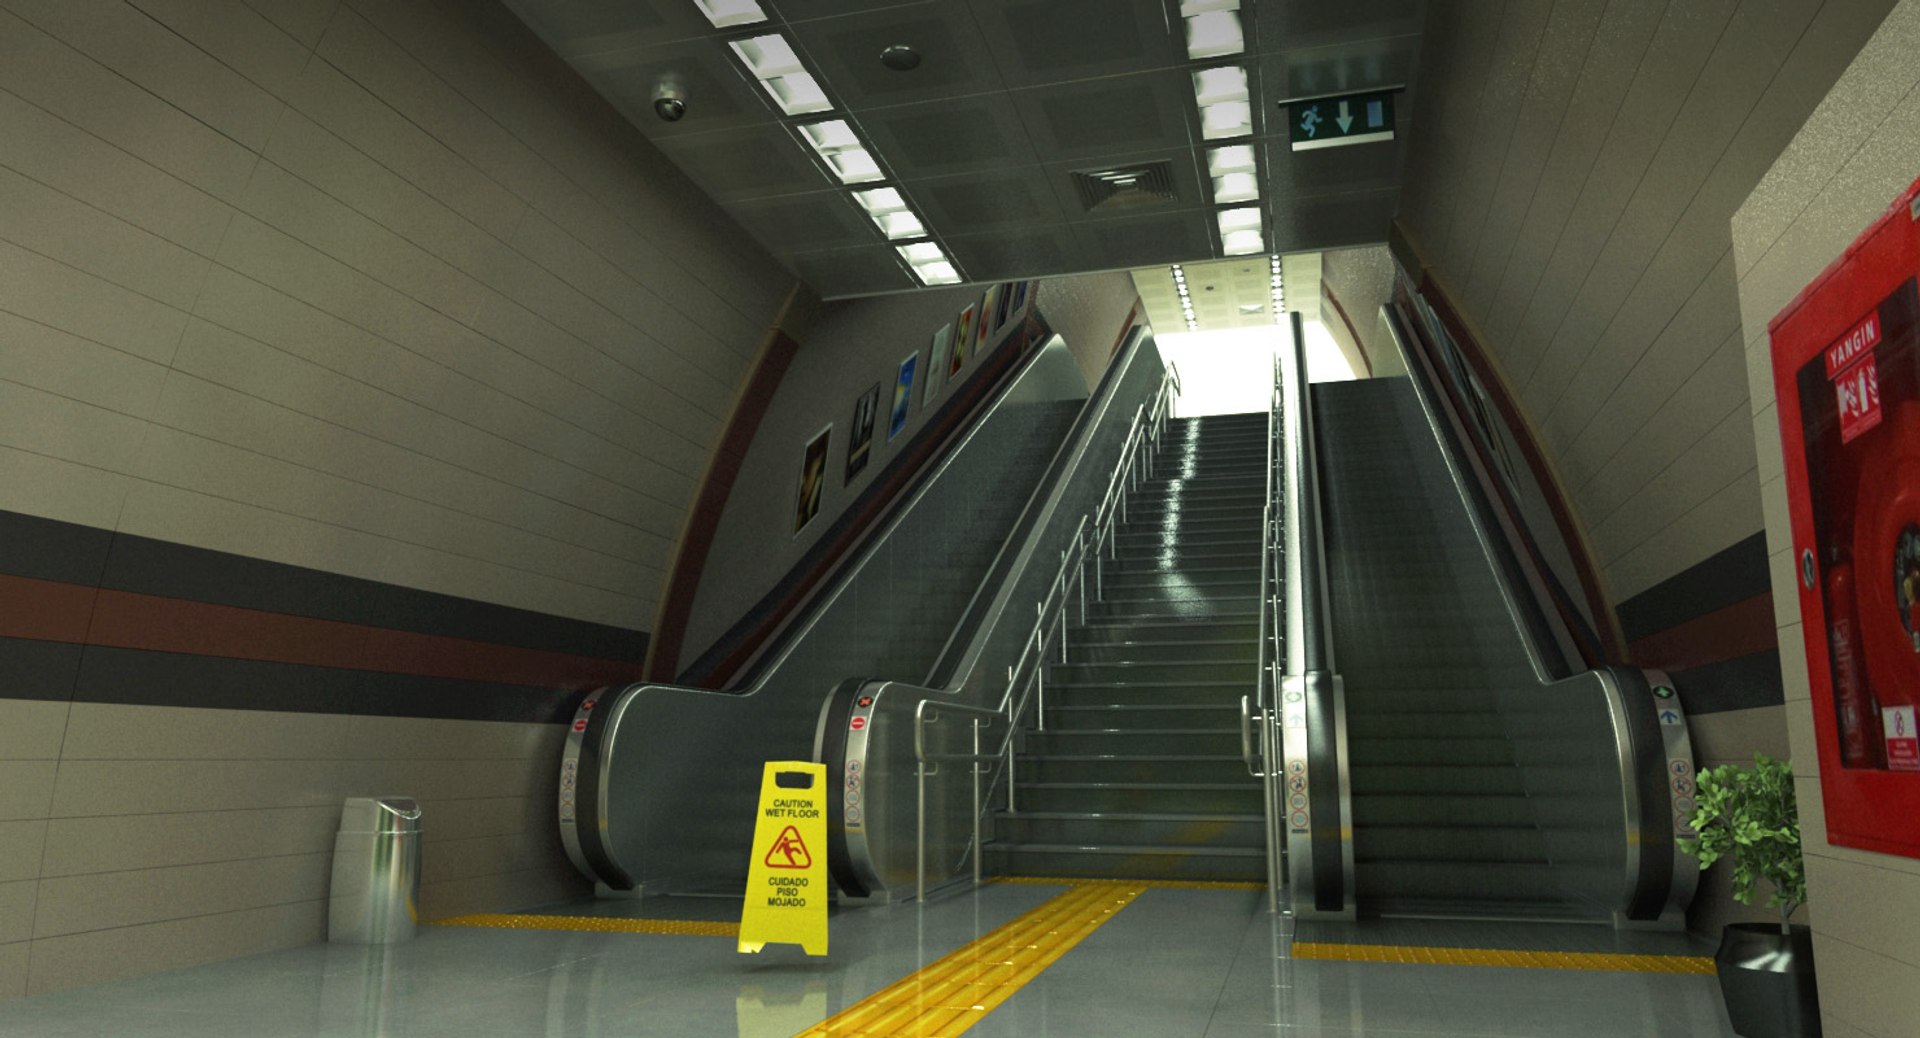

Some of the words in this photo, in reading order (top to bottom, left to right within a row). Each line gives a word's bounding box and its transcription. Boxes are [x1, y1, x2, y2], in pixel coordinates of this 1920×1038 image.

[1831, 319, 1875, 369] YANGIN
[773, 799, 813, 808] CAUTION
[765, 808, 785, 817] WET
[787, 809, 819, 818] FLOOR
[768, 877, 809, 887] CUIDADO
[777, 887, 798, 896] PISO
[768, 897, 806, 907] MOJADO
